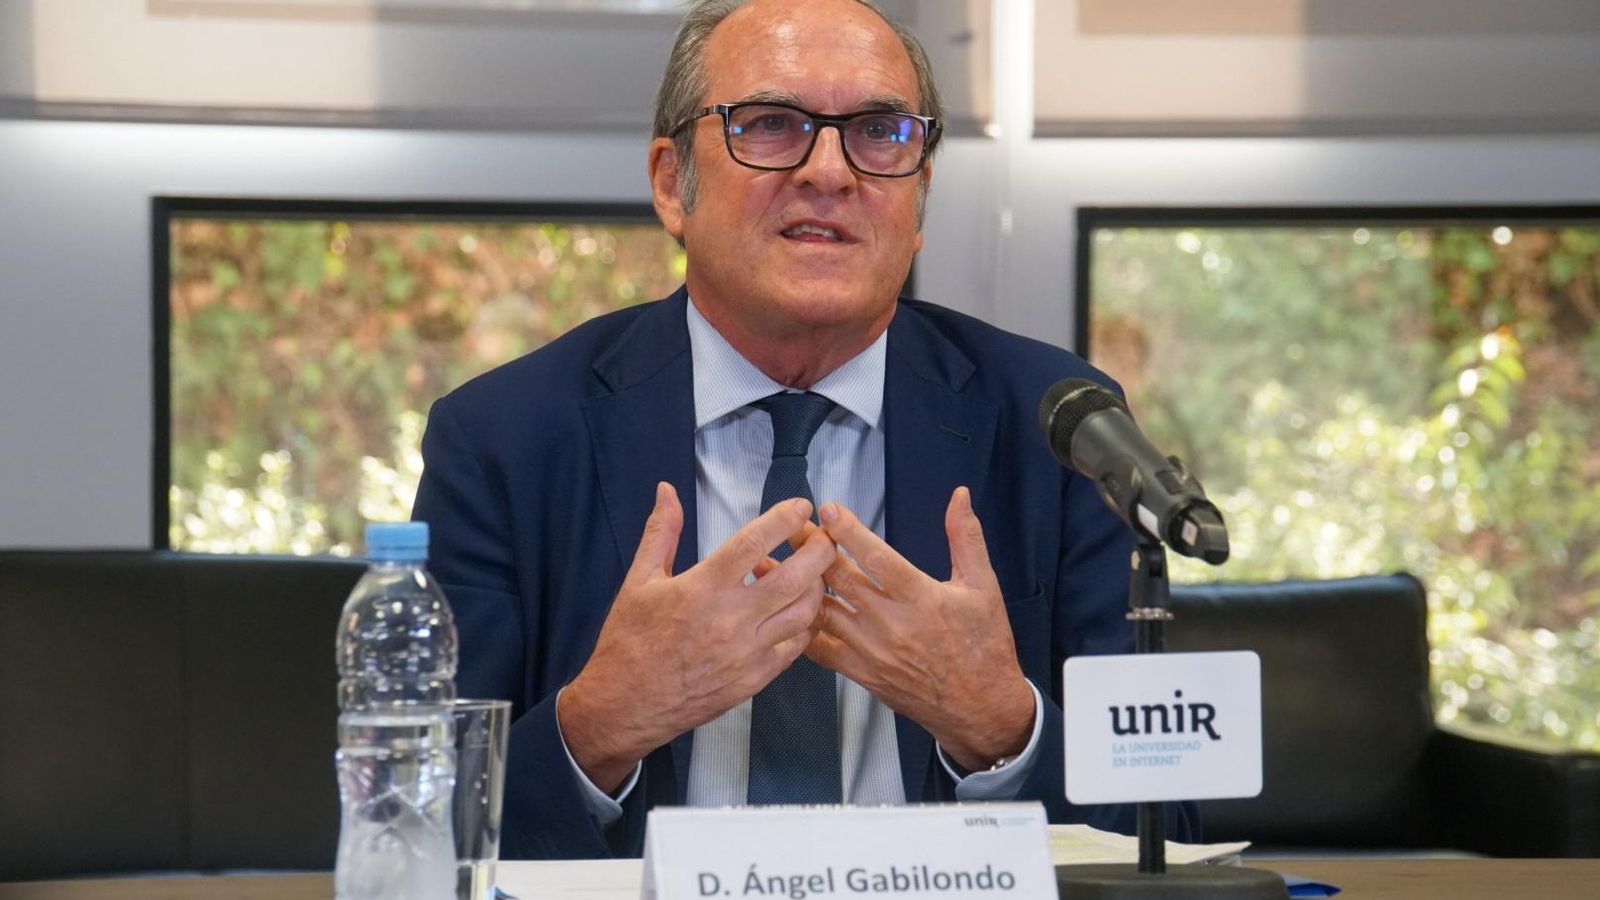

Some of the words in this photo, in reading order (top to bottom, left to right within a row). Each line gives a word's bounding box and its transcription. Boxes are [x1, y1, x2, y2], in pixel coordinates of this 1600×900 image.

[1112, 743, 1126, 754] LA
[1129, 740, 1202, 753] UNIVERSIDAD
[1112, 756, 1127, 768] EN
[1129, 755, 1182, 768] INTERNET
[698, 872, 731, 897] D.
[743, 863, 835, 900] Ángel
[845, 864, 1016, 893] Gabilondo
